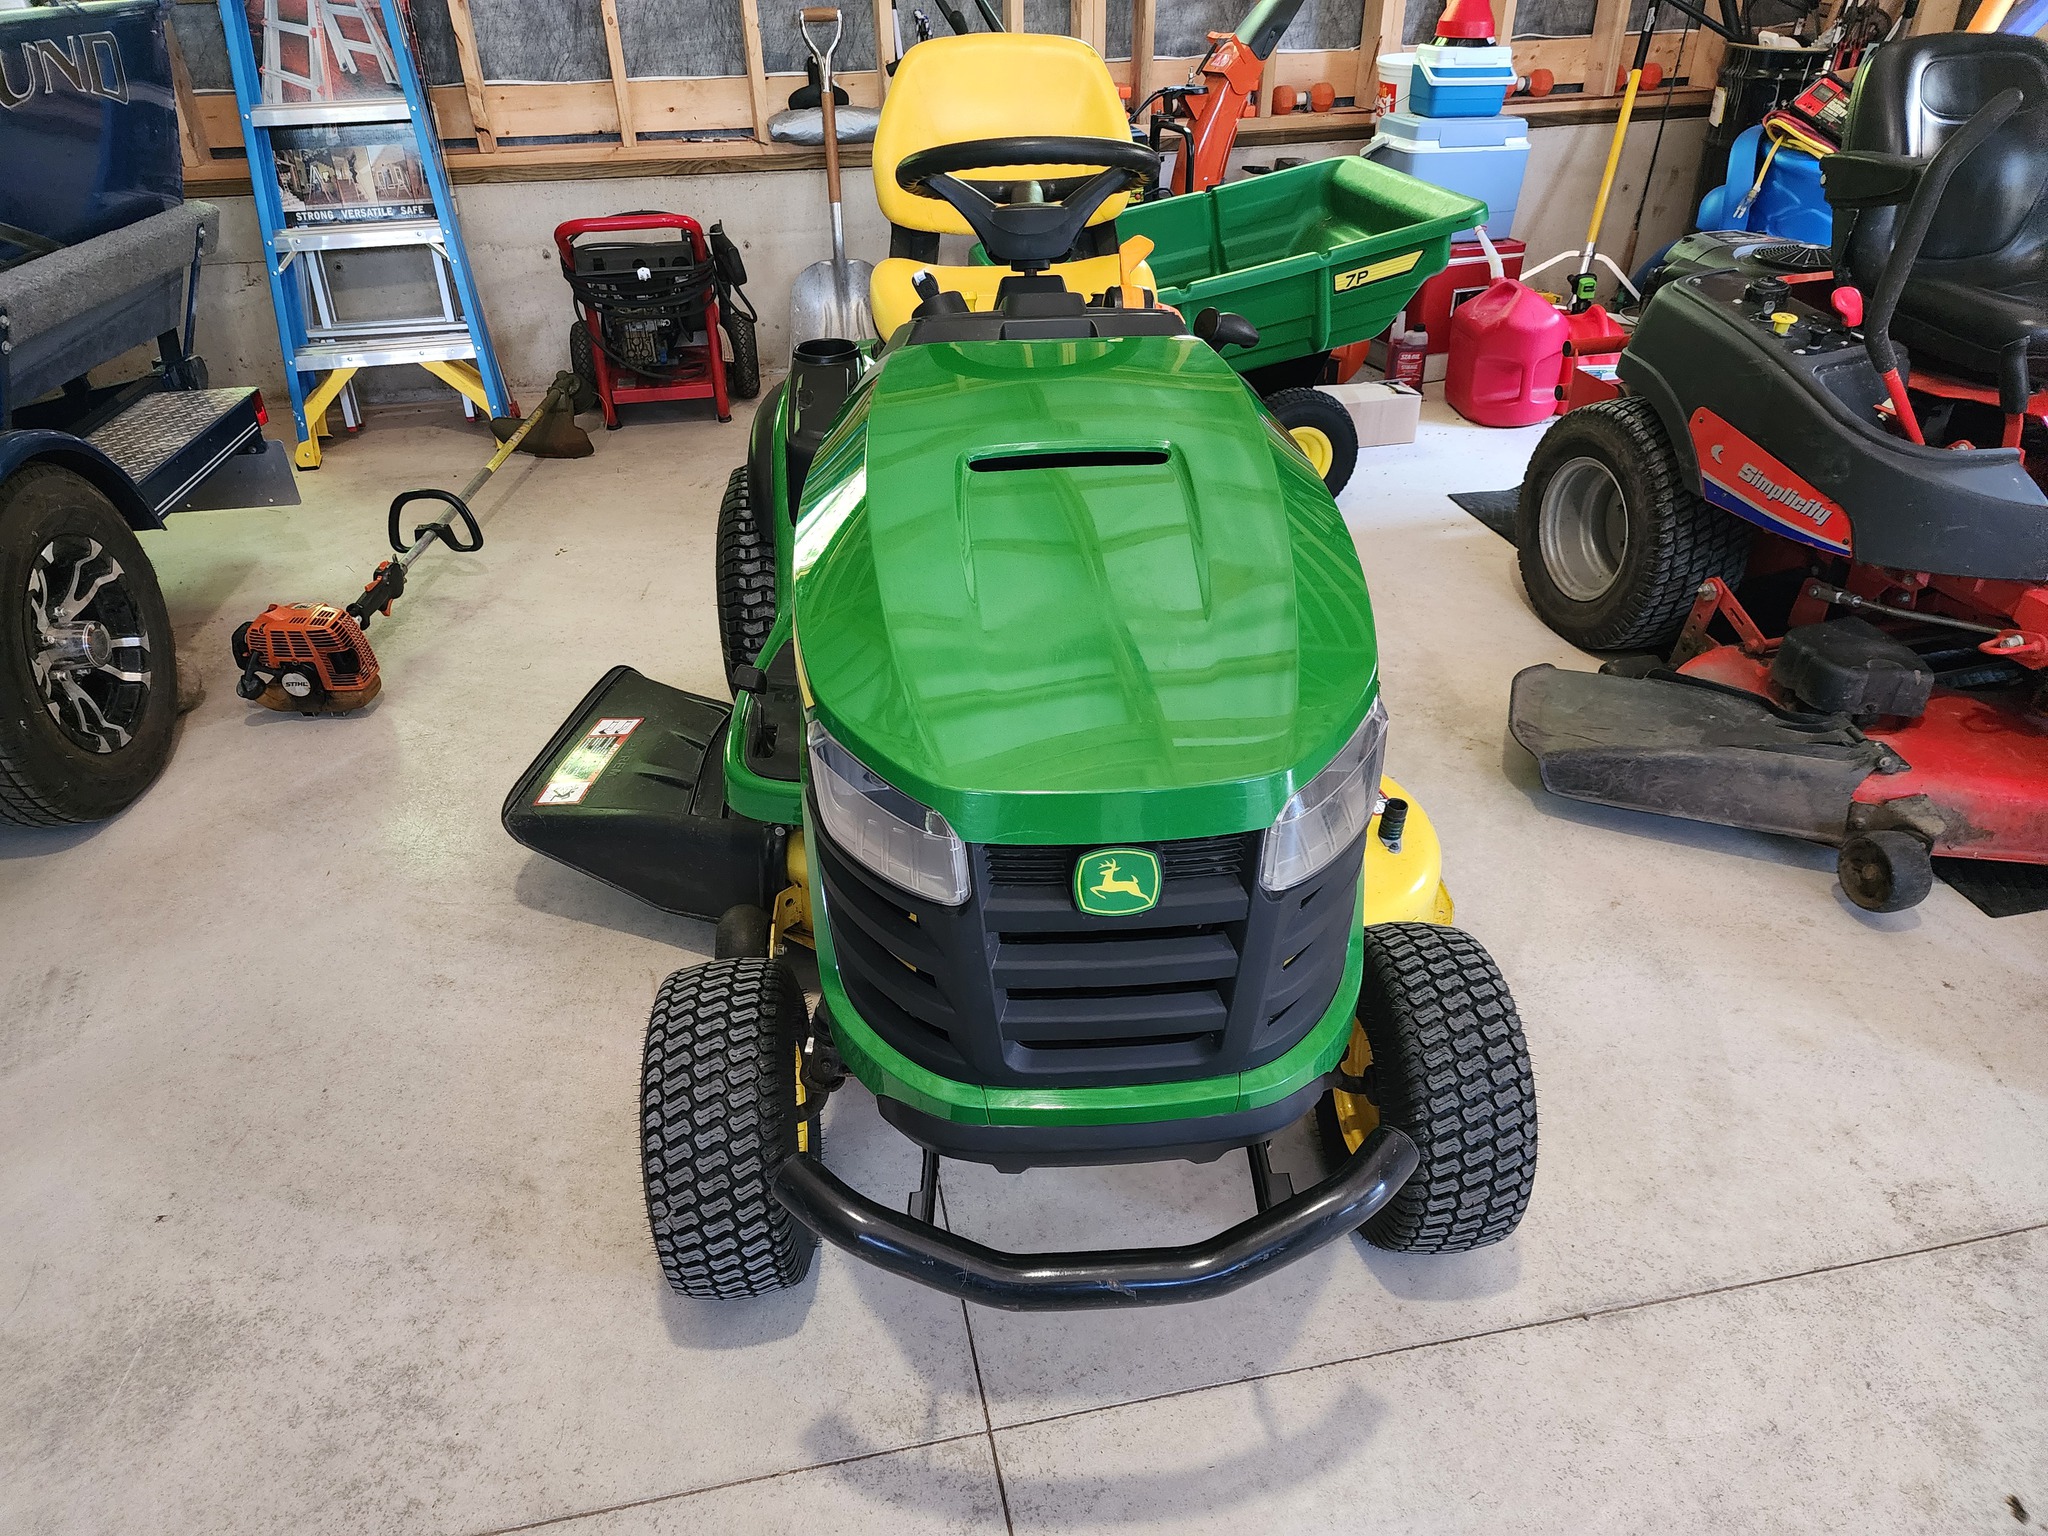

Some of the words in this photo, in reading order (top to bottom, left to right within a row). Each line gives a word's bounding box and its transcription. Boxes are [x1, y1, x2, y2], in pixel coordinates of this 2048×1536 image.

[295, 210, 335, 221] STRONG
[341, 206, 394, 218] VERSATILE
[400, 205, 425, 215] SAFE
[1345, 270, 1369, 288] 7P
[1737, 462, 1833, 526] Simplicity
